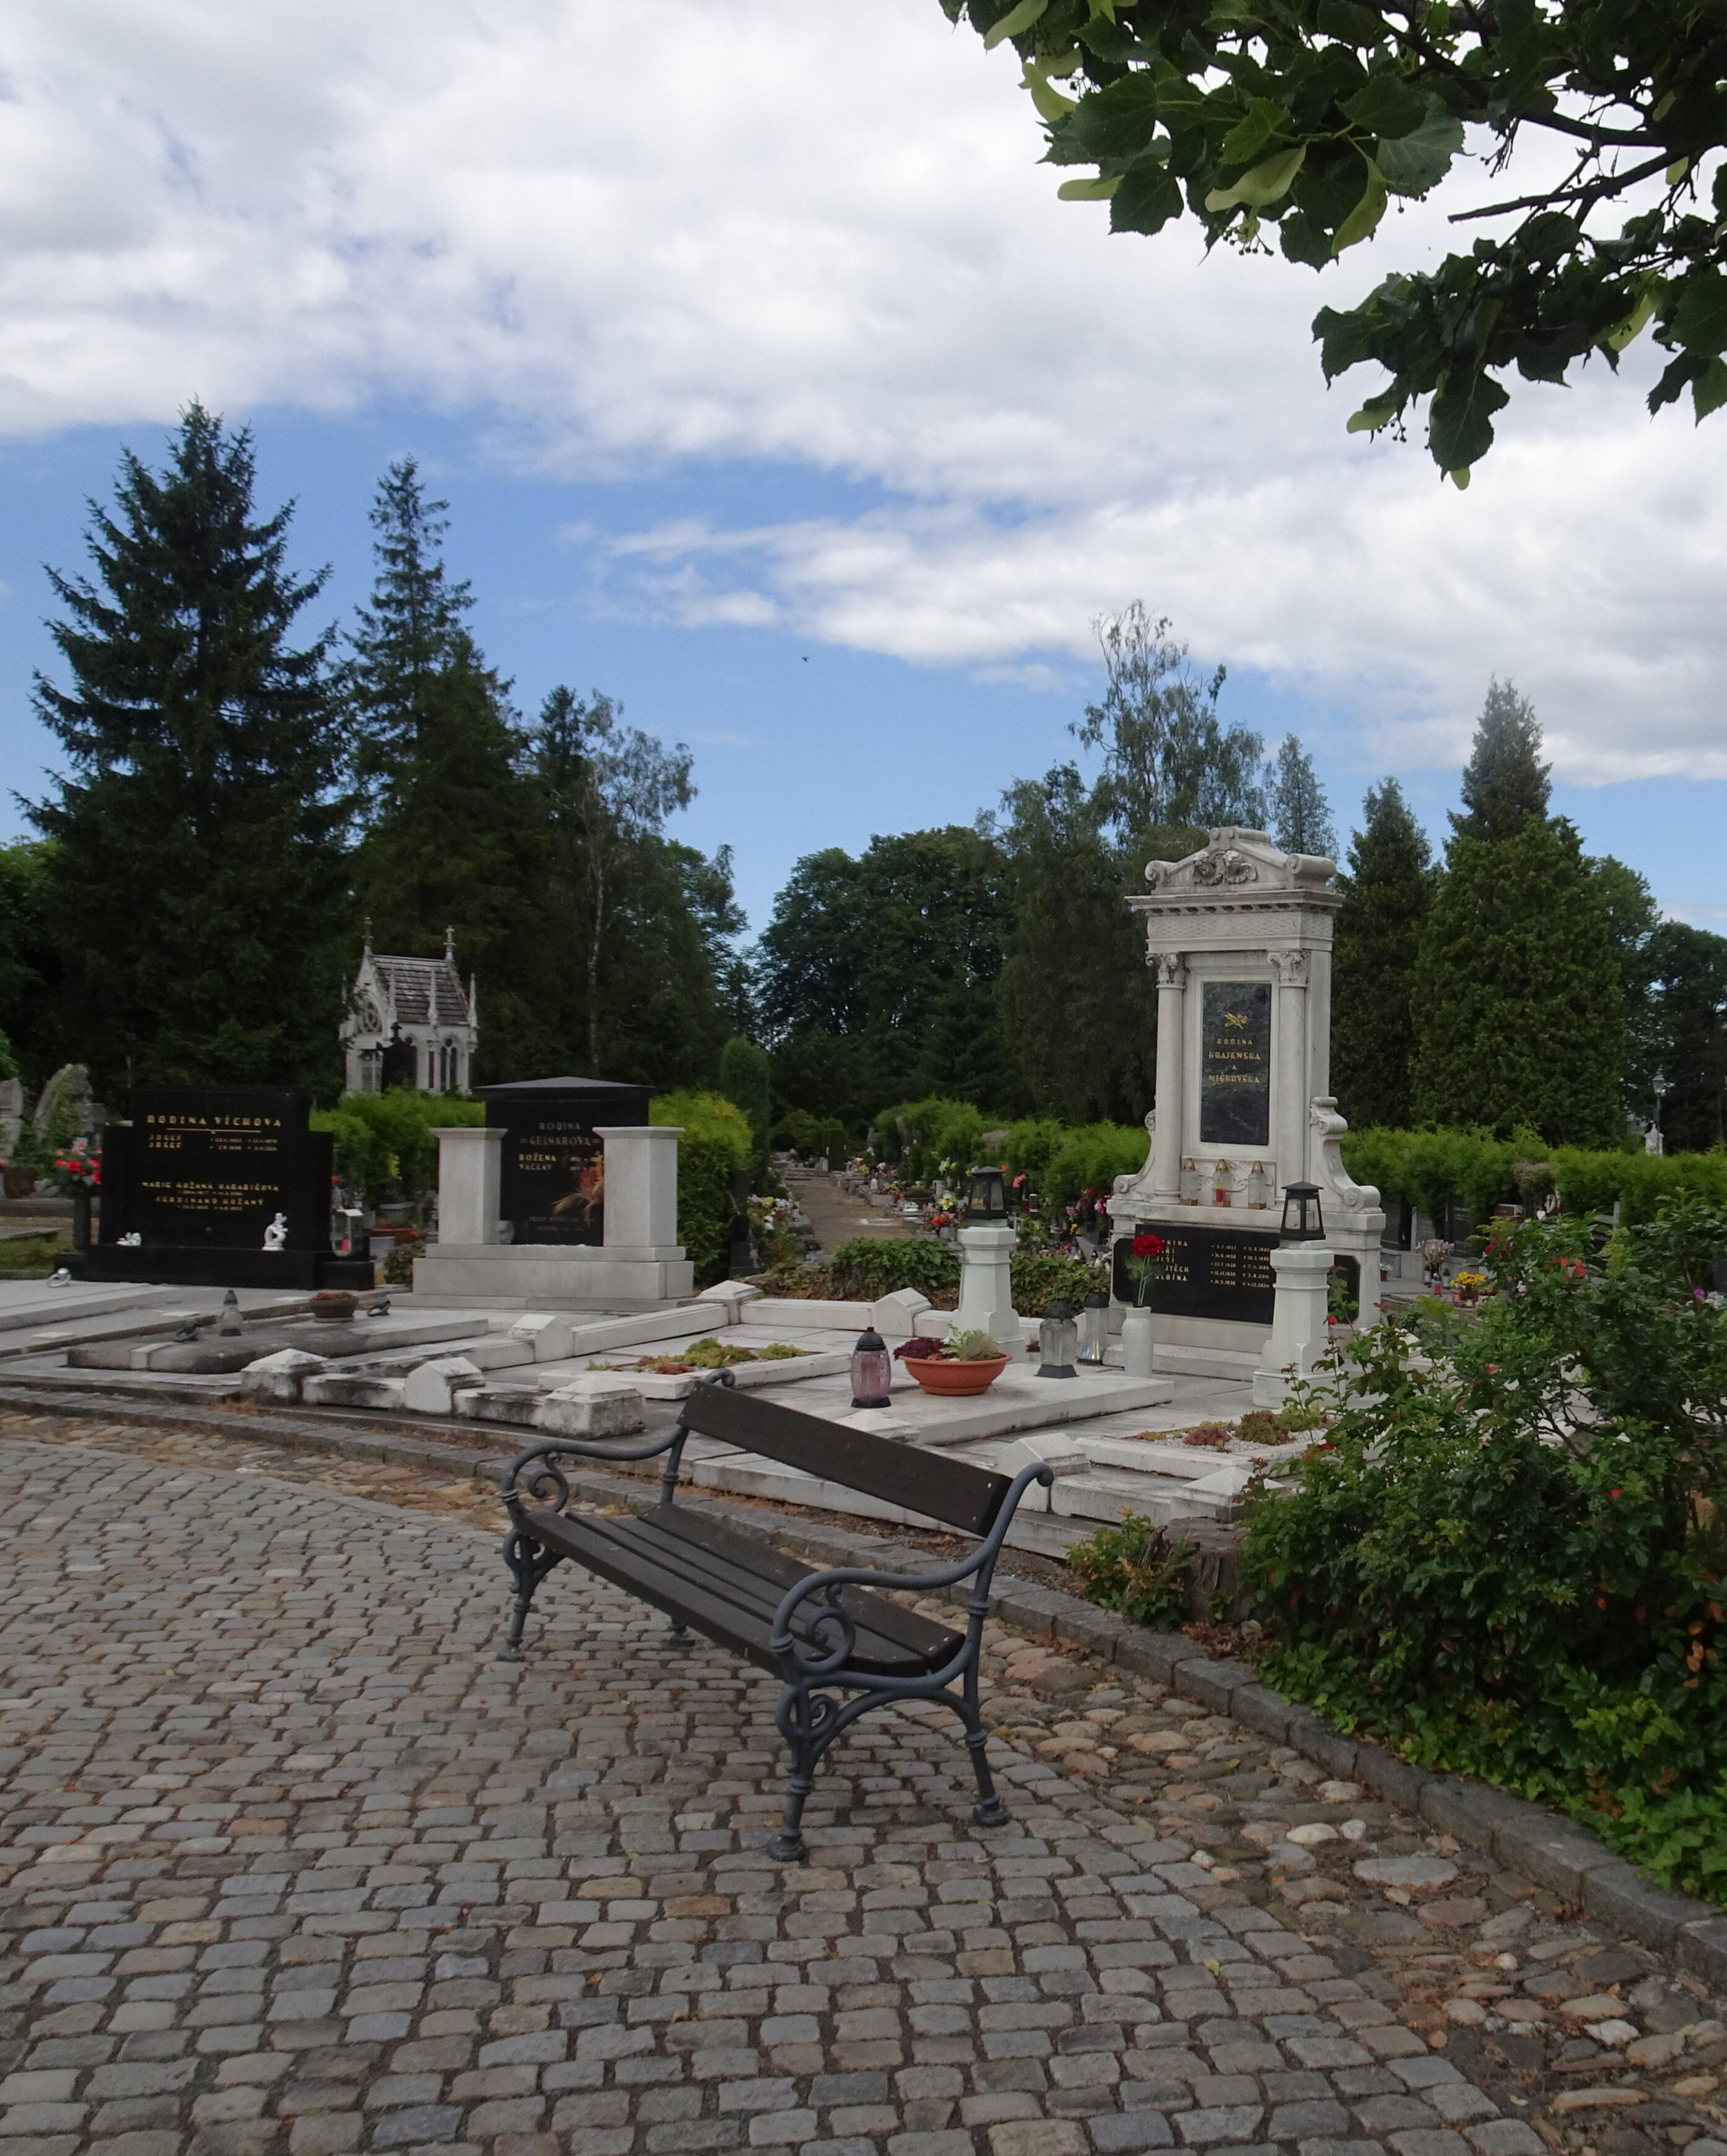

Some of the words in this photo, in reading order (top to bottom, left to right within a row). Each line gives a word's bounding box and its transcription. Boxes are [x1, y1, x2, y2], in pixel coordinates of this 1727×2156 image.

[147, 1115, 207, 1125] RODINA
[539, 1122, 581, 1130] RODINA
[518, 1152, 556, 1161] BOŽENA
[1165, 1263, 1189, 1273] JTĚCH
